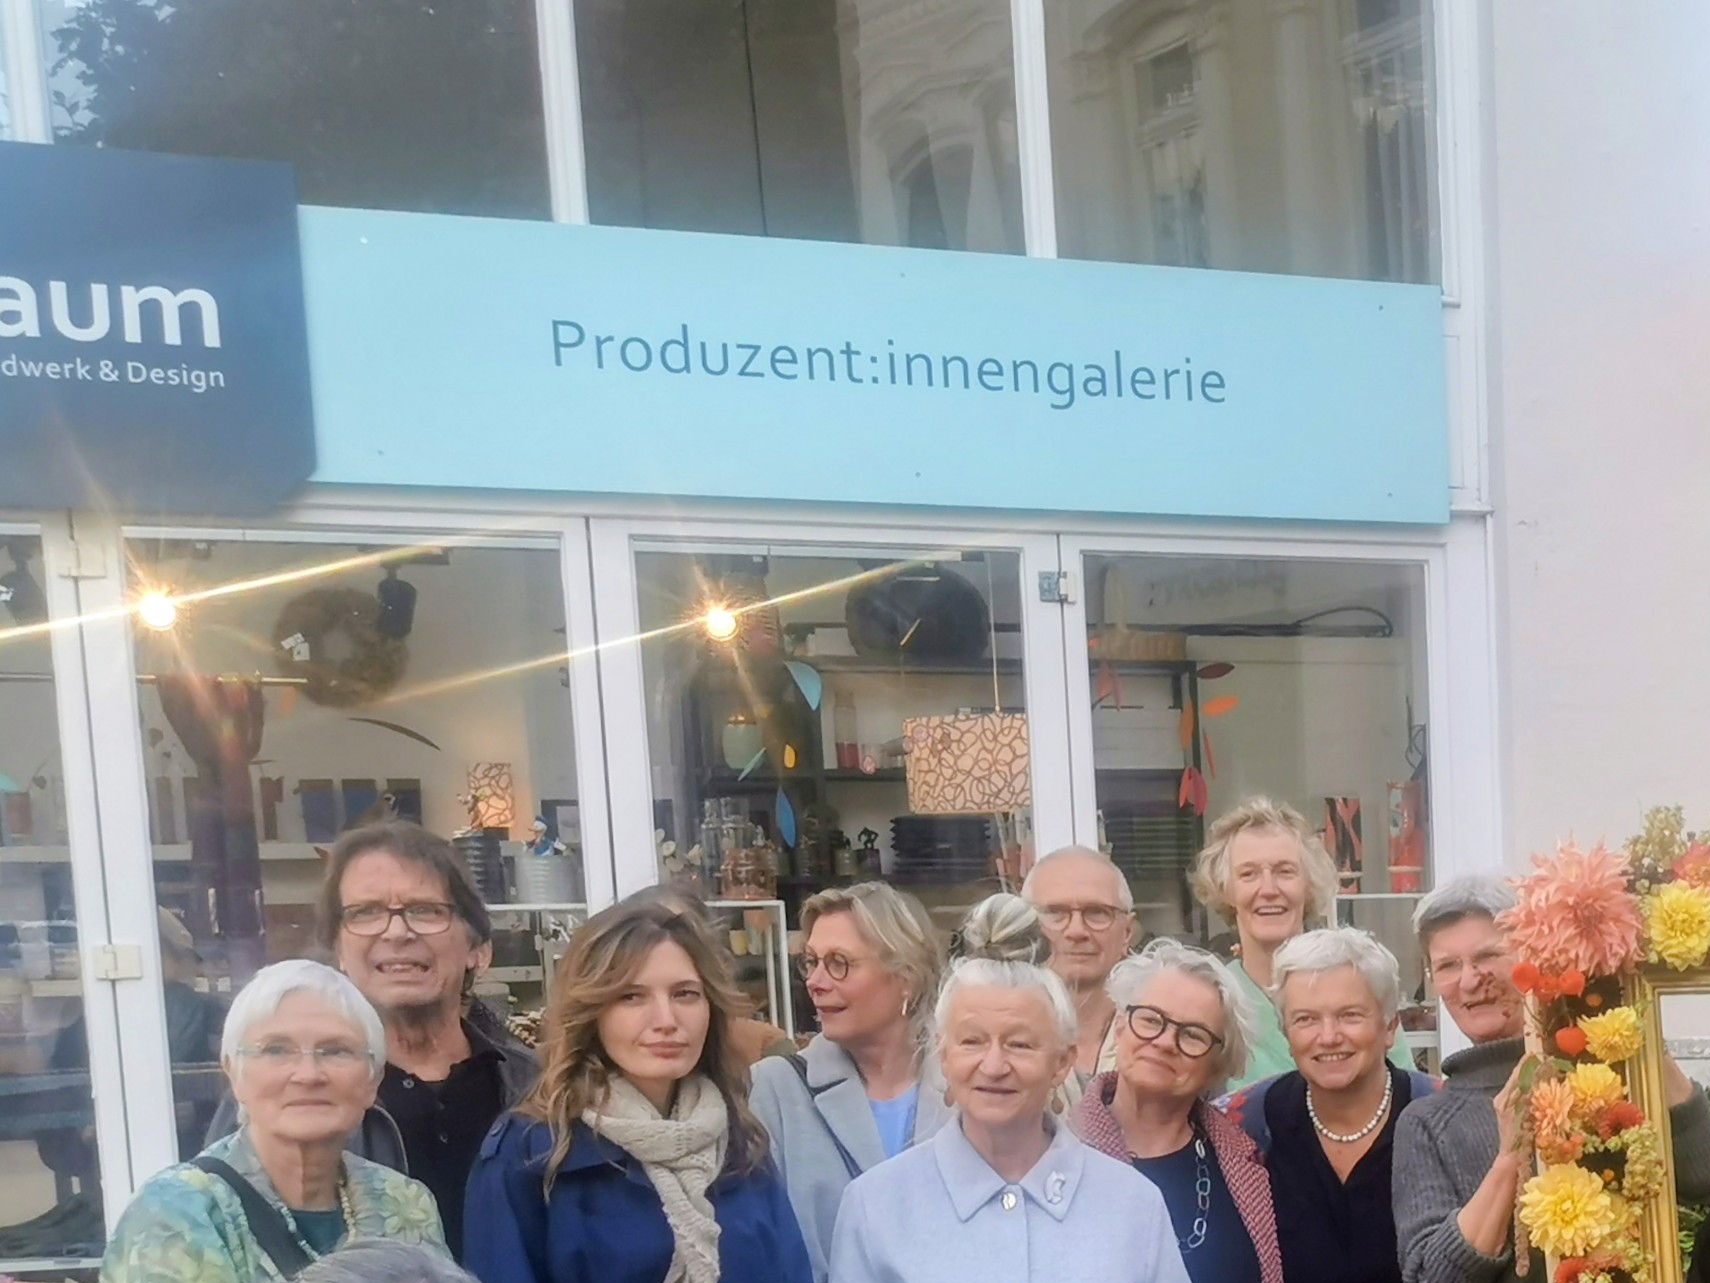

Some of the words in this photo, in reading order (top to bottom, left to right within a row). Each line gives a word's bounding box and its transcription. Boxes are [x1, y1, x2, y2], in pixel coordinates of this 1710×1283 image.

[99, 360, 120, 383] &
[127, 361, 226, 393] Design
[550, 319, 1228, 410] Produzent:innengalerie
